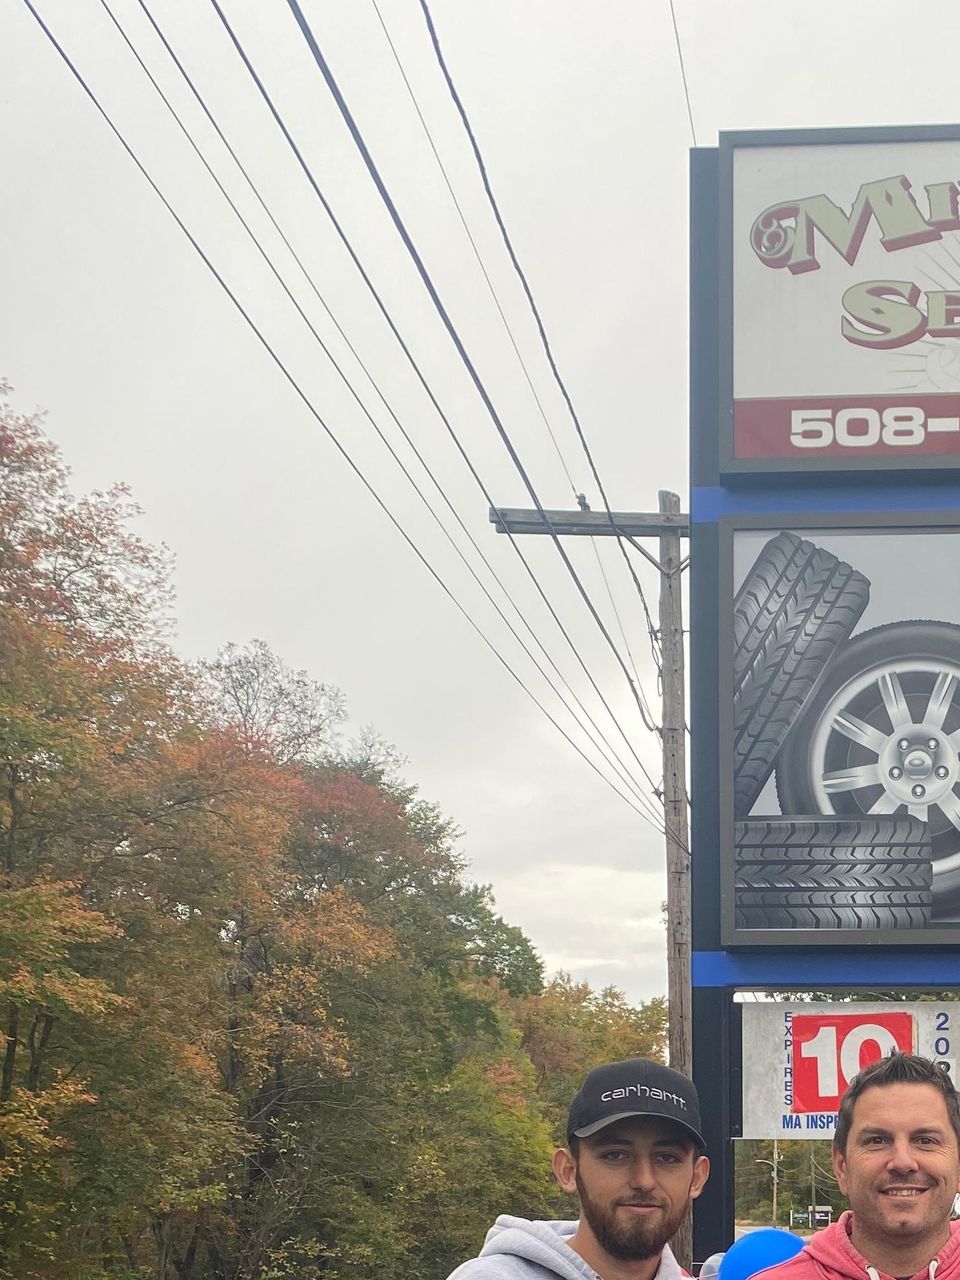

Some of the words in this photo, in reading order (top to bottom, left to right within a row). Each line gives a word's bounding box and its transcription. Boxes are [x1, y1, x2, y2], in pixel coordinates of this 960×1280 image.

[801, 1024, 900, 1098] 10
[601, 1084, 686, 1110] carhartt
[782, 1115, 801, 1129] MA
